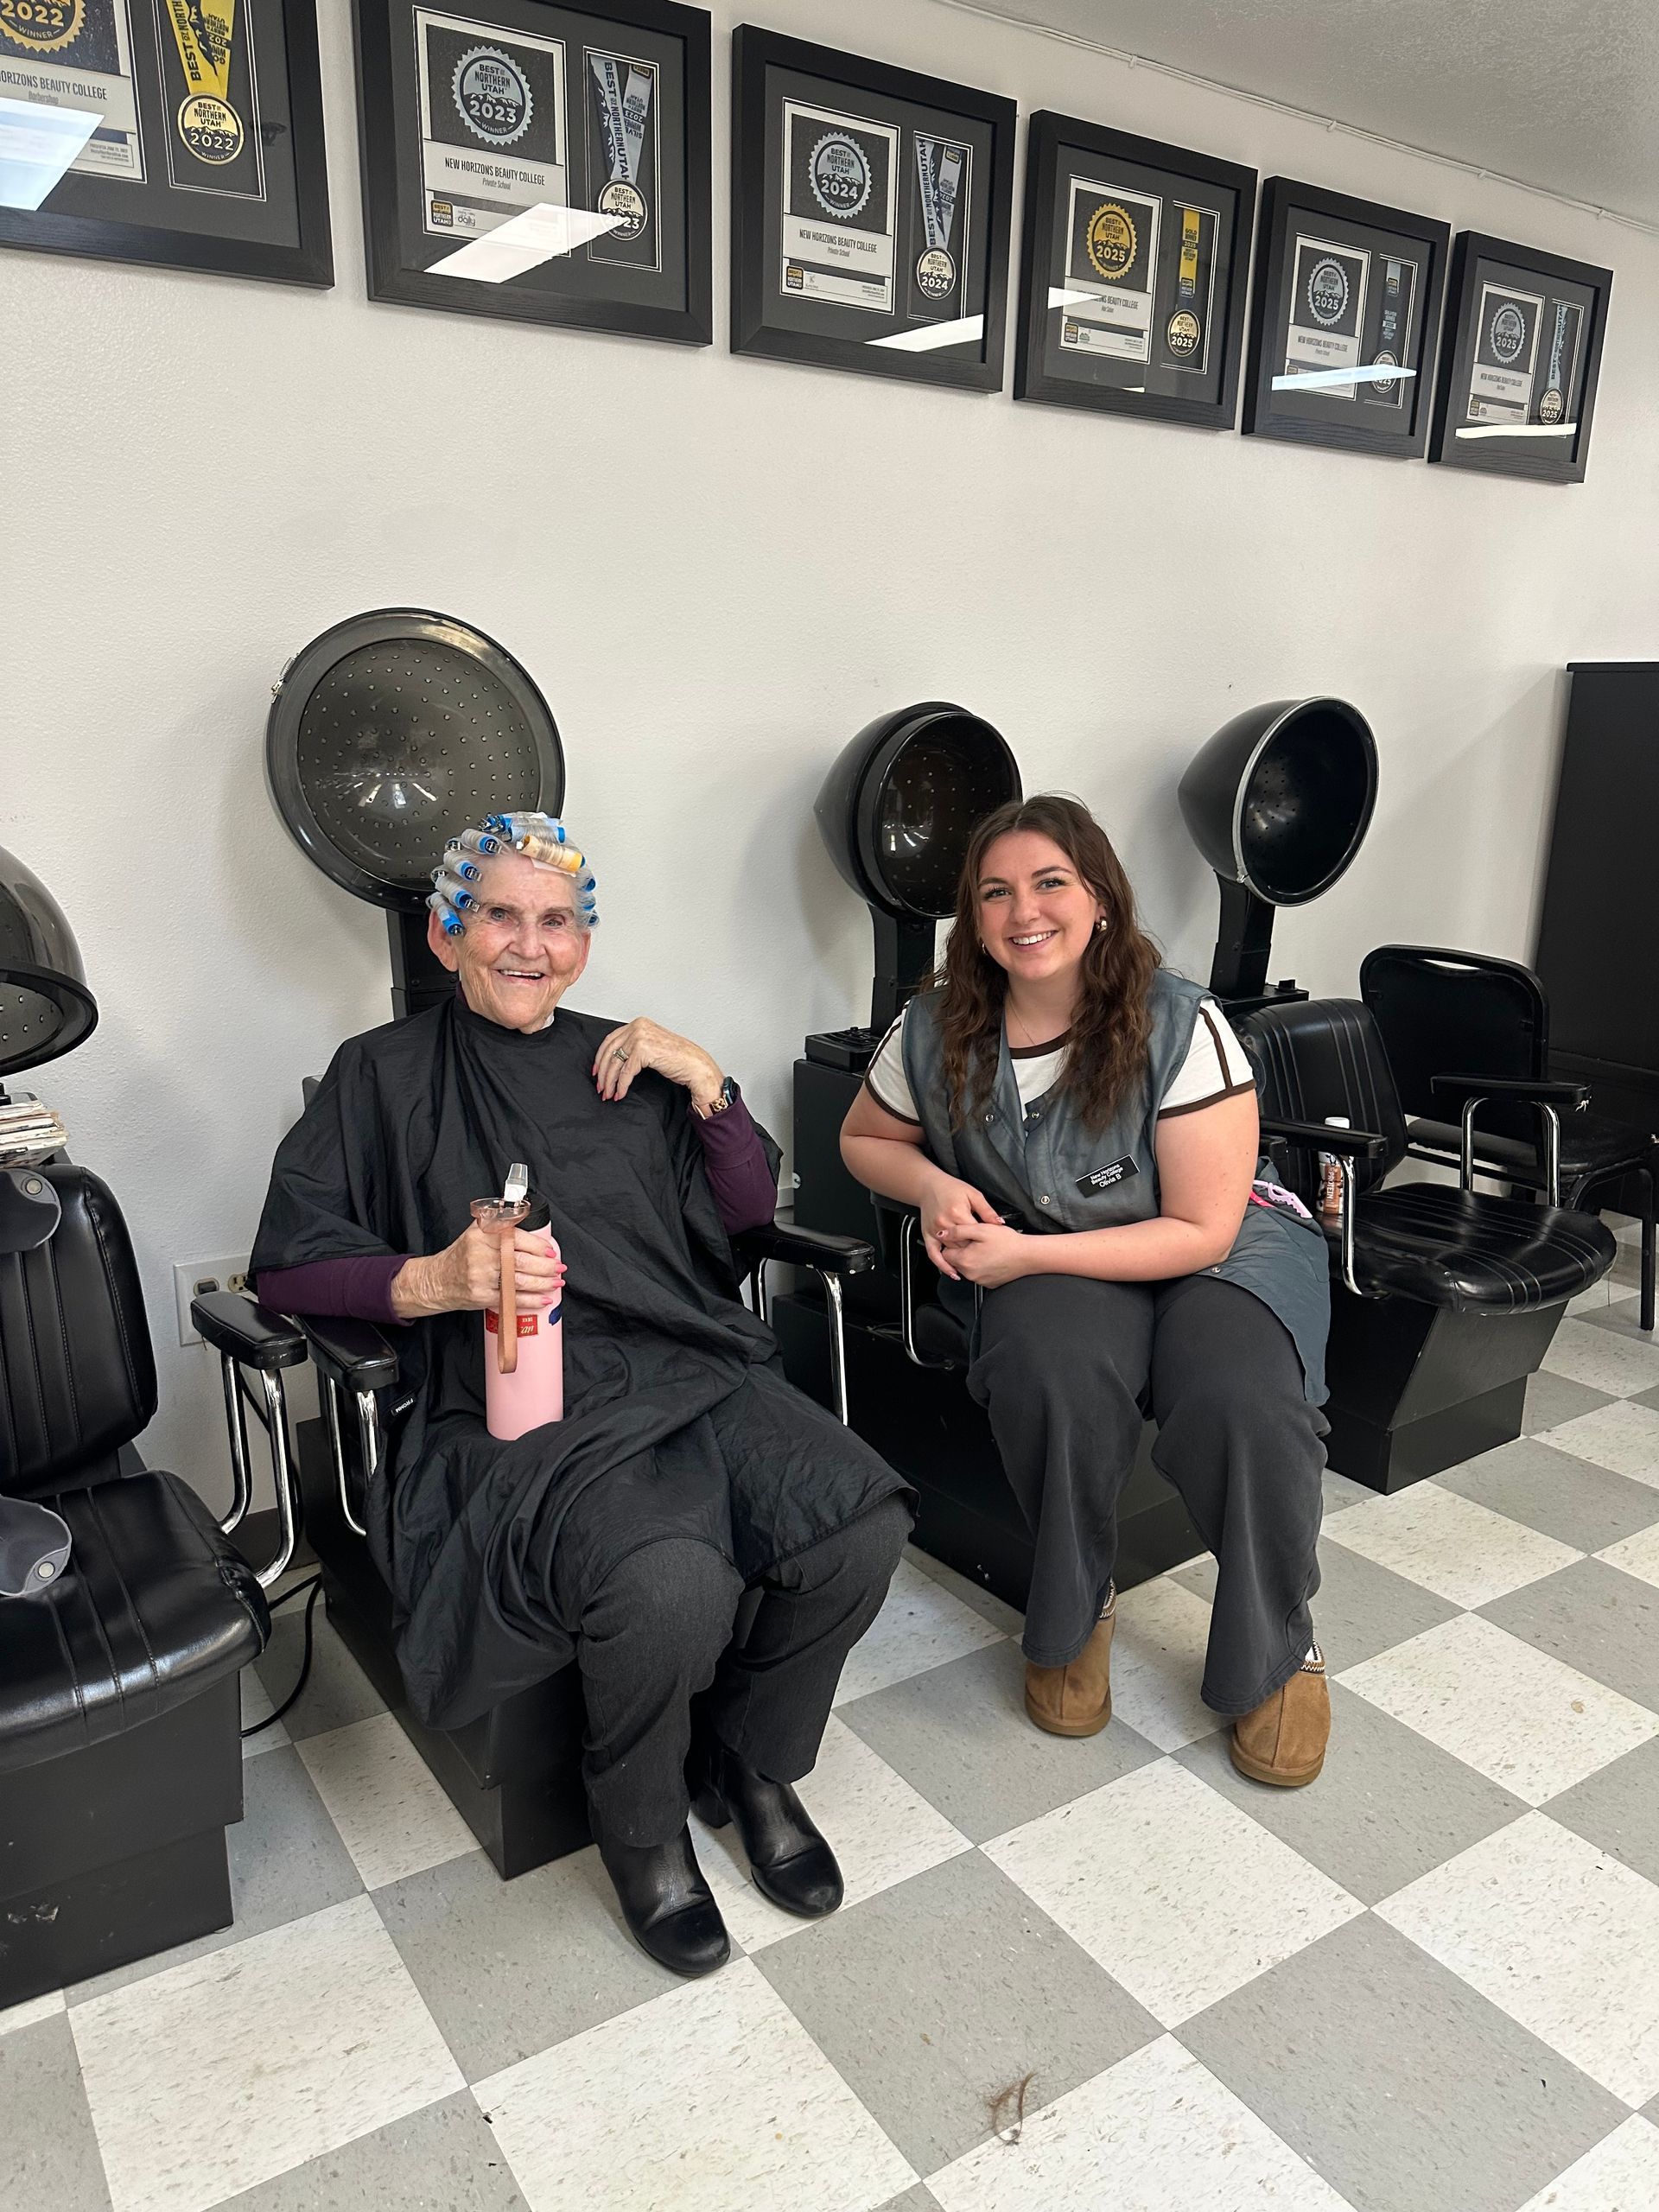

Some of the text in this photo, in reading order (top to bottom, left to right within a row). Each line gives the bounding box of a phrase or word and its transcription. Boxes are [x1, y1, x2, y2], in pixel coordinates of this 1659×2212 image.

[0, 0, 64, 27] 2022
[18, 25, 53, 39] WINNER
[182, 42, 201, 80] BEST
[479, 64, 499, 73] BEST
[474, 71, 511, 88] NORTHERN
[40, 77, 71, 93] BEAUTY
[73, 82, 107, 100] COLLEGE
[481, 83, 505, 94] UTAH
[198, 102, 216, 111] BEST
[469, 99, 517, 124] 2023
[605, 62, 617, 97] BEST
[611, 106, 625, 148] NORTHERN
[194, 108, 226, 121] NORTHERN
[624, 110, 643, 123] 2023
[200, 118, 221, 128] UTAH
[481, 122, 507, 134] WINNER
[190, 132, 234, 151] 2022
[201, 151, 225, 160] WINNER
[830, 148, 846, 156] BEST
[919, 138, 928, 172] UTAH
[827, 154, 855, 168] NORTHERN
[445, 157, 545, 186] NEW HORIZONS BEAUTY COLLEGE
[831, 165, 849, 175] UTAH
[482, 177, 512, 190] Private School
[821, 179, 858, 200] 2024
[611, 192, 636, 204] NORTHERN
[615, 200, 632, 209] UTAH
[928, 216, 937, 245] BEST
[799, 228, 878, 254] NEW HORIZONS BEAUTY COLLEGE
[1096, 245, 1126, 263] 2025
[921, 276, 949, 290] 2024
[1314, 296, 1338, 310] 2025
[1171, 336, 1193, 347] 2025
[1496, 336, 1516, 349] 2025
[1541, 409, 1558, 419] 2025
[1099, 1177, 1116, 1187] Olivia
[1326, 1172, 1335, 1199] PROTEIN
